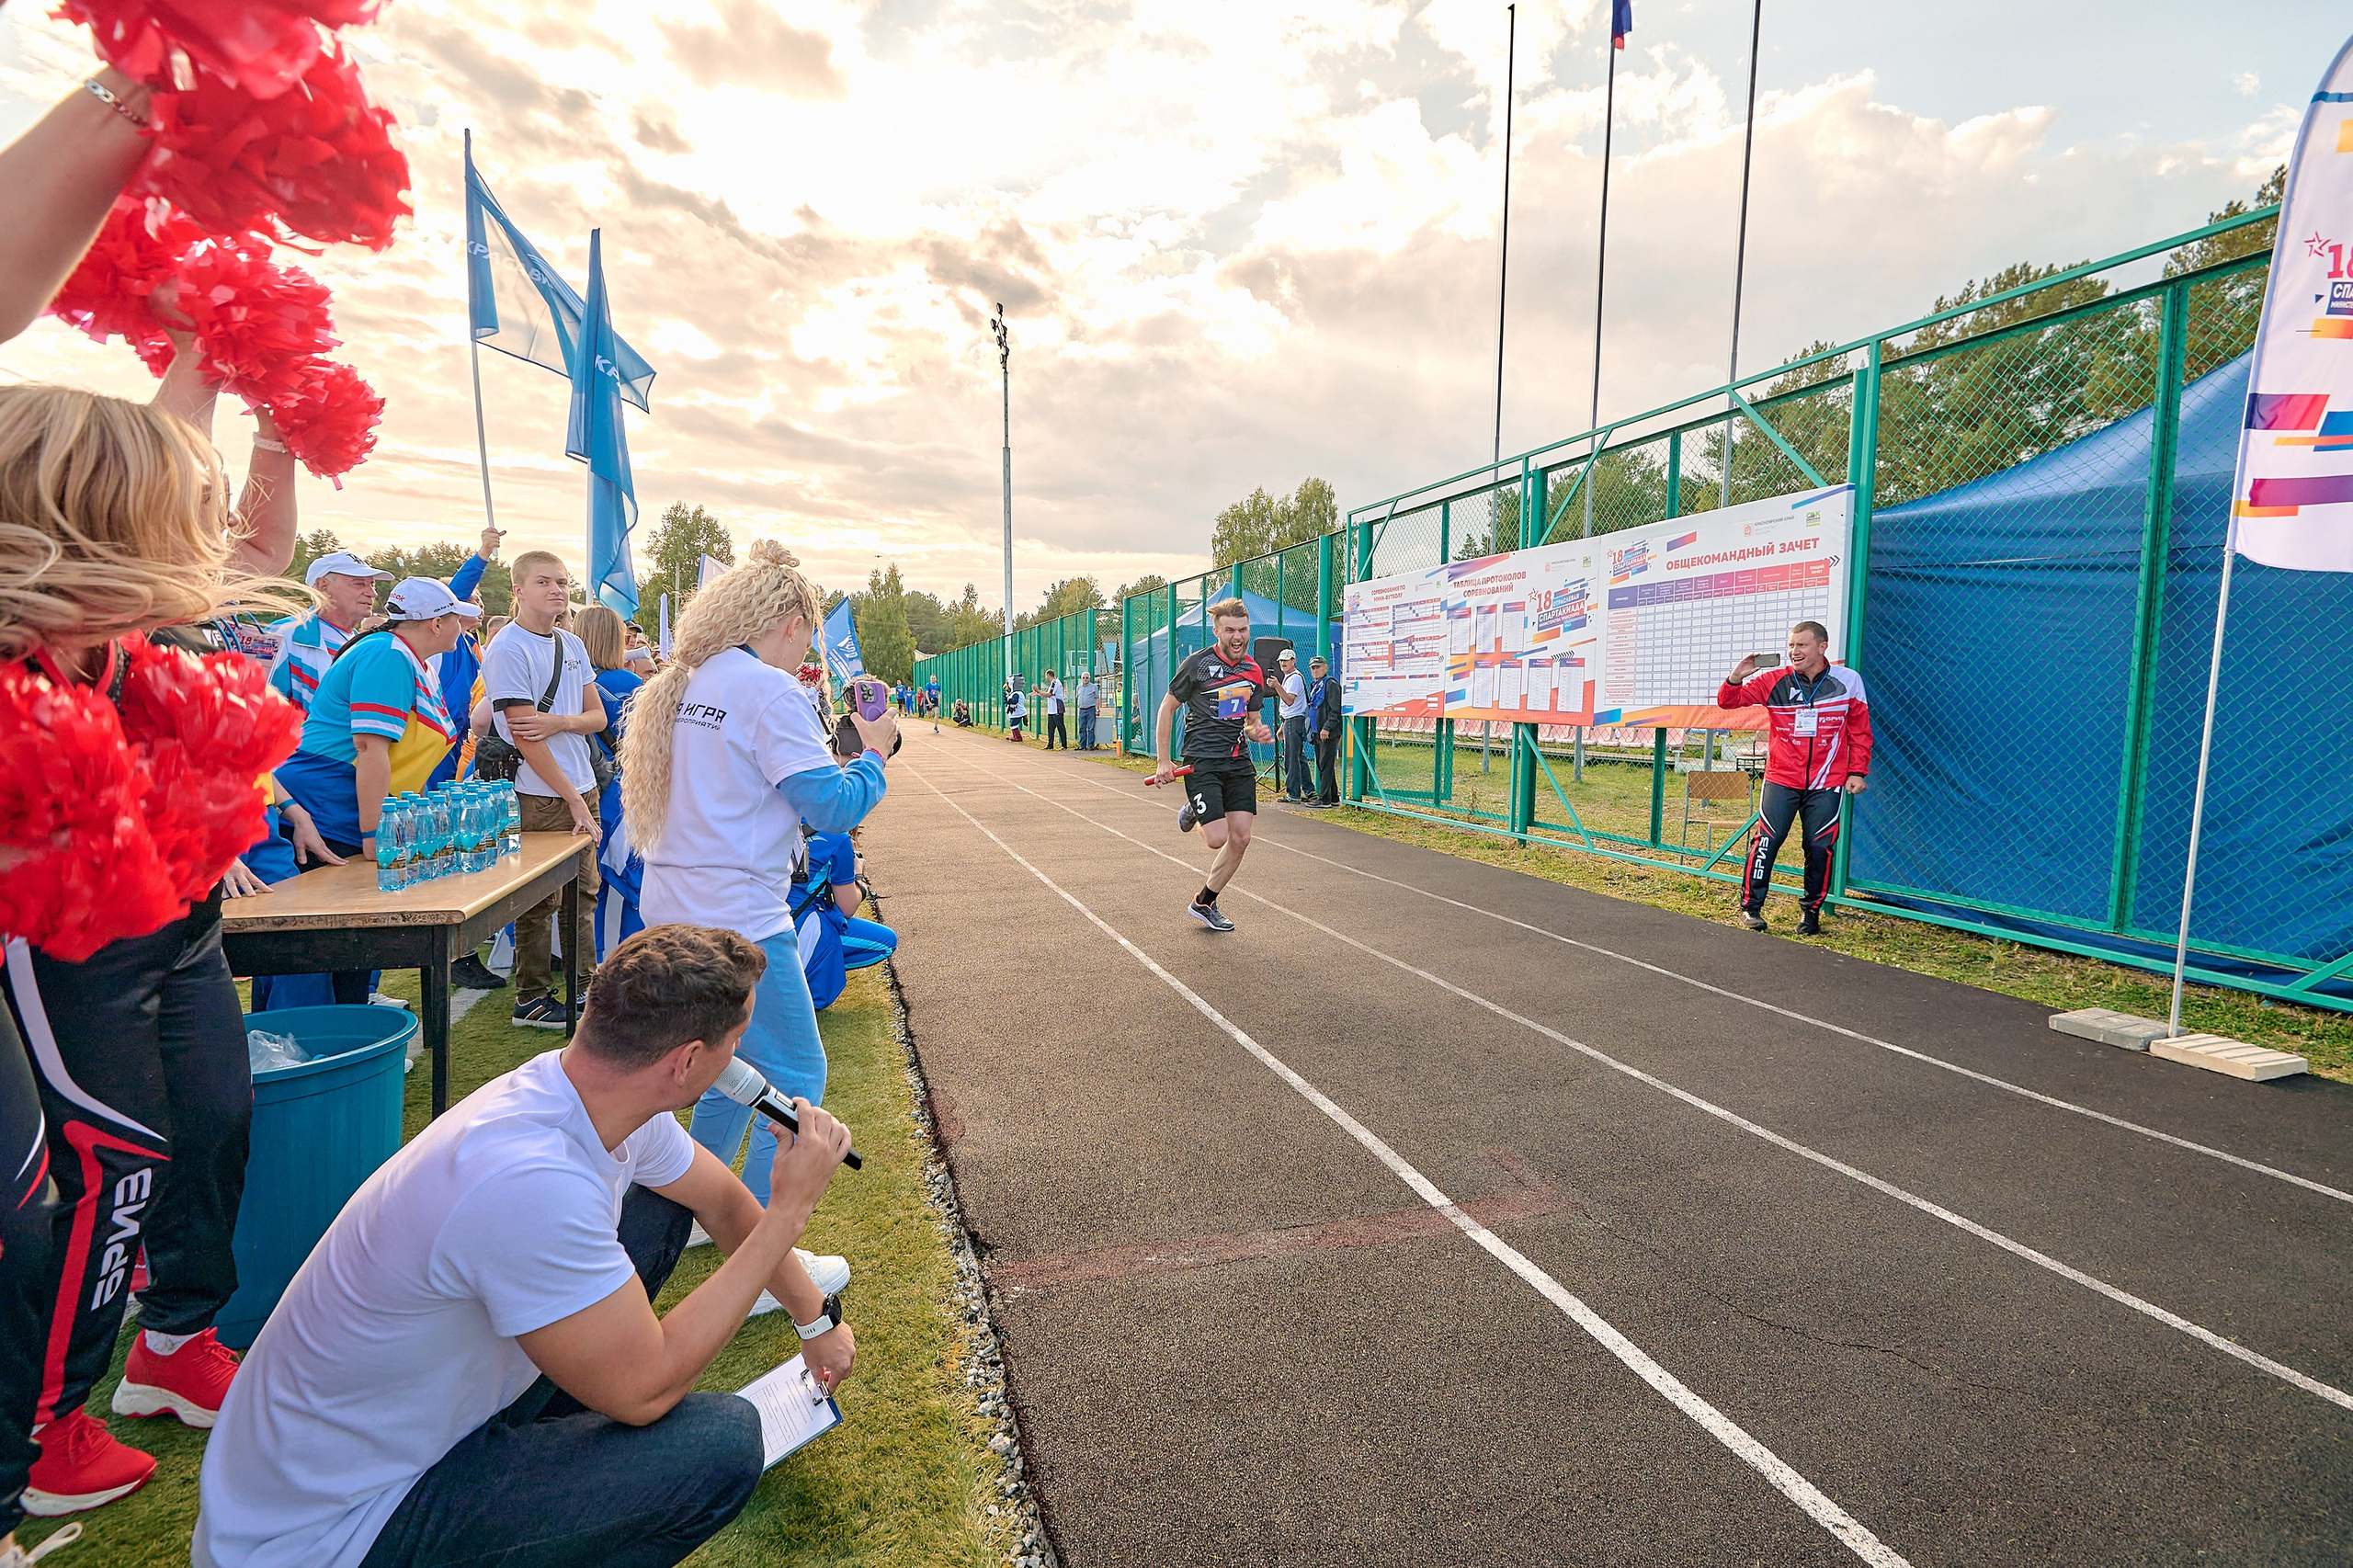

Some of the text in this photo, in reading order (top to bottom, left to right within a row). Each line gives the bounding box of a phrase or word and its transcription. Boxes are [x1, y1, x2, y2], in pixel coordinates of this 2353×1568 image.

[1612, 550, 1623, 564] 18
[1666, 542, 1774, 571] ОБЩЕКОМАНДНЫЙ
[1779, 538, 1820, 553] ЗАЧЕТ
[1453, 571, 1527, 588] ТАБЛИЦА ПРОТОКОЛОВ
[1463, 582, 1514, 597] СОРЕВНОВАНИЙ
[1537, 590, 1552, 613] 18
[1553, 594, 1579, 607] ОТРАСЛЕВАЯ
[1539, 601, 1584, 622] СПАРТАКИАДА
[683, 703, 728, 723] ИГРА
[1231, 699, 1239, 712] 7
[676, 717, 721, 731] ЕРОПРИЯТИЙ
[1193, 792, 1207, 814] 3
[1753, 836, 1769, 880] БРИЗ
[91, 1167, 152, 1312] БРИЗ
